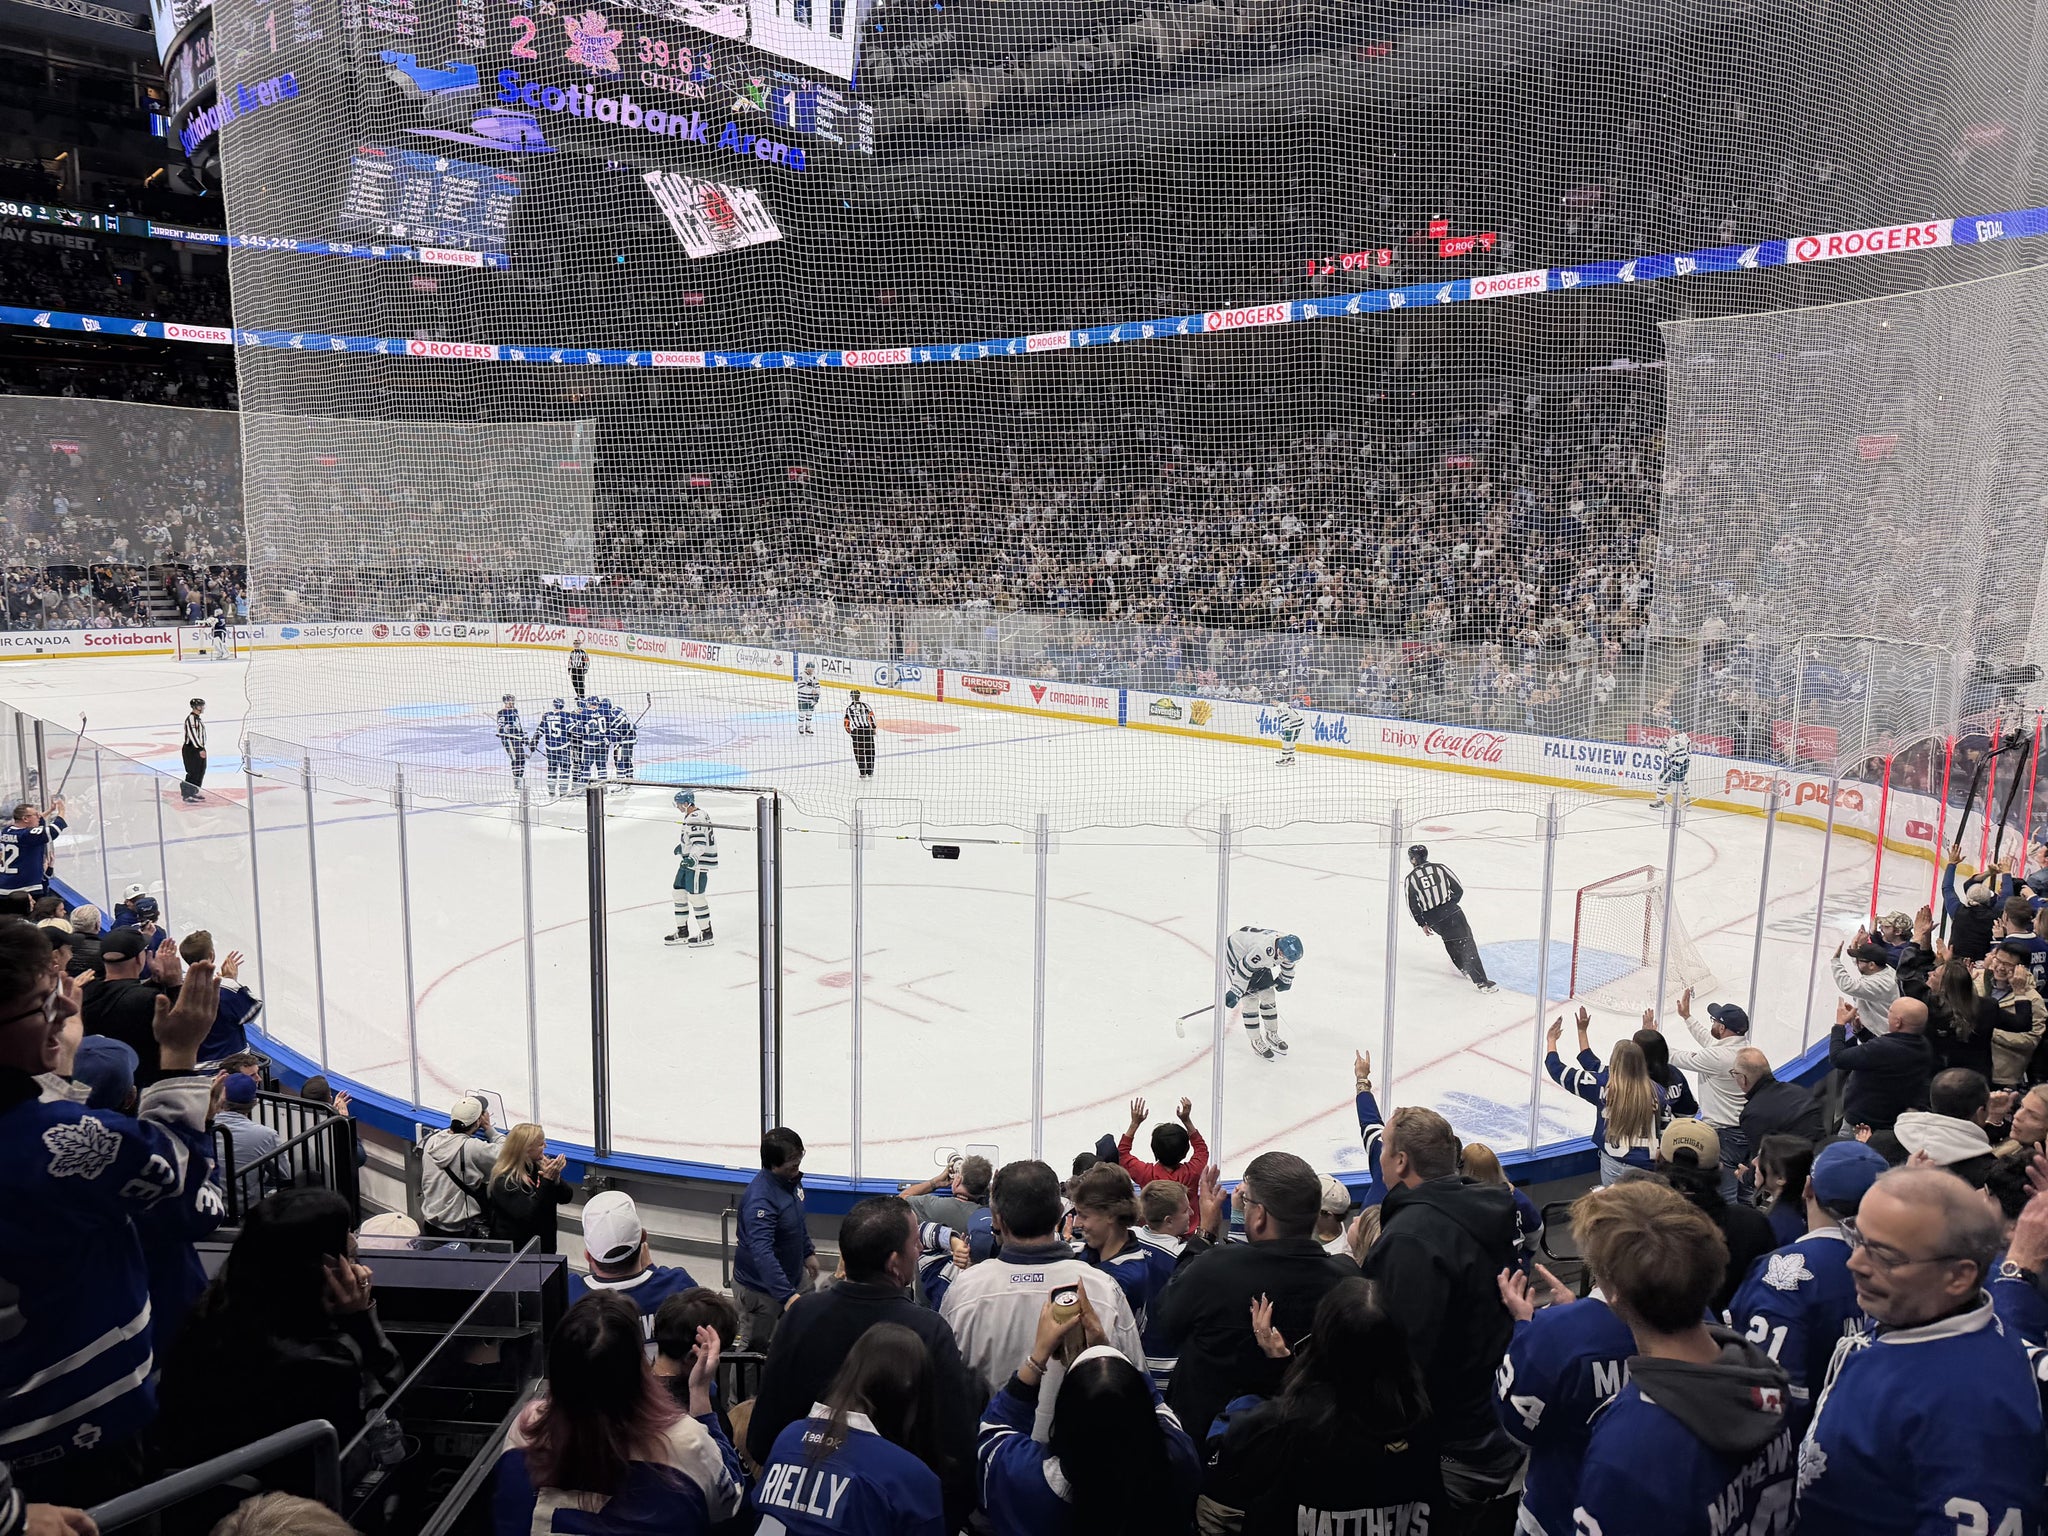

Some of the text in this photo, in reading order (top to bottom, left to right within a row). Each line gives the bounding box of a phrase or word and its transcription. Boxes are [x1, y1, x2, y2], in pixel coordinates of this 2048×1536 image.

[510, 15, 537, 59] 2
[638, 36, 693, 74] 39.6
[237, 71, 299, 117] Arena
[640, 70, 706, 100] CITIZEN
[783, 90, 796, 128] 1
[497, 69, 806, 171] Scotiabank Arena
[355, 158, 394, 173] TORONTO
[459, 178, 480, 189] JOSE
[39, 206, 47, 214] 3
[91, 214, 100, 229] 1
[377, 224, 386, 235] 2
[1976, 220, 2005, 243] GOAL
[30, 231, 97, 251] STREET
[239, 233, 298, 251] $45,242
[1827, 224, 1938, 257] ROGERS
[437, 251, 477, 264] ROGERS
[1489, 275, 1541, 293] ROGERS
[1225, 305, 1285, 328] ROGERS
[181, 328, 226, 341] ROGERS
[1037, 334, 1067, 347] ROGERS
[430, 343, 492, 358] ROGERS
[665, 353, 701, 364] ROGERS
[861, 349, 906, 364] ROGERS
[84, 631, 173, 646] Scotiabank
[303, 625, 363, 639] salesforce
[392, 626, 411, 637] LG
[434, 626, 451, 637] LG
[504, 623, 567, 643] Molson
[587, 631, 619, 647] ROGERS
[14, 635, 71, 647] CANADA
[636, 637, 667, 653] Castrol
[680, 641, 722, 662] POINTSBET
[821, 658, 852, 675] PATH
[963, 676, 1009, 691] FIREHOUSE
[1049, 691, 1109, 710] CANADIAN TIRE
[1311, 714, 1351, 745] Milk
[1381, 727, 1508, 764] Enjoy Coca-Cola
[1543, 741, 1627, 767] FALLSVIEW
[1575, 764, 1653, 782] NIAGARA FALLS
[1420, 874, 1436, 889] 61
[1672, 1137, 1705, 1152] MICHIGAN
[1010, 1272, 1045, 1284] CCM
[1745, 1315, 1788, 1365] 21
[758, 1462, 851, 1520] RIELLY
[1297, 1500, 1431, 1536] MATTHEWS
